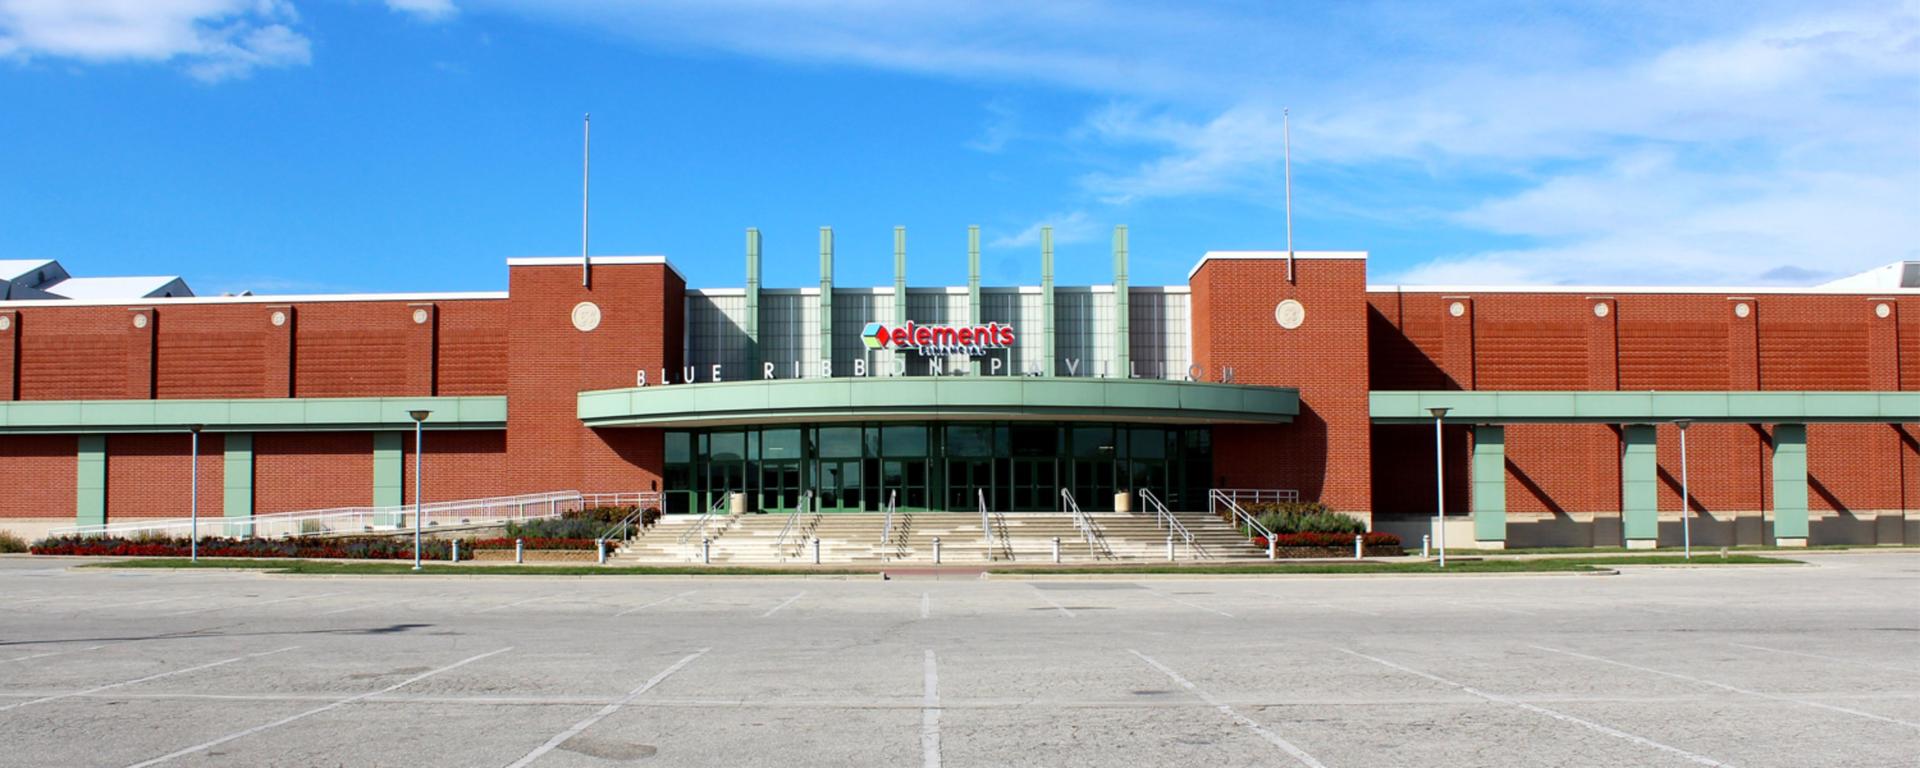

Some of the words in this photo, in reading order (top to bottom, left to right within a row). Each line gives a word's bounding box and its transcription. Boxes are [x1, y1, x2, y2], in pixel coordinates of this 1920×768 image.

[891, 321, 1014, 346] elements
[919, 346, 986, 356] FINANCIAL
[637, 365, 721, 386] BLUE
[764, 357, 942, 379] RIBBON
[991, 358, 1234, 383] PAVILION
